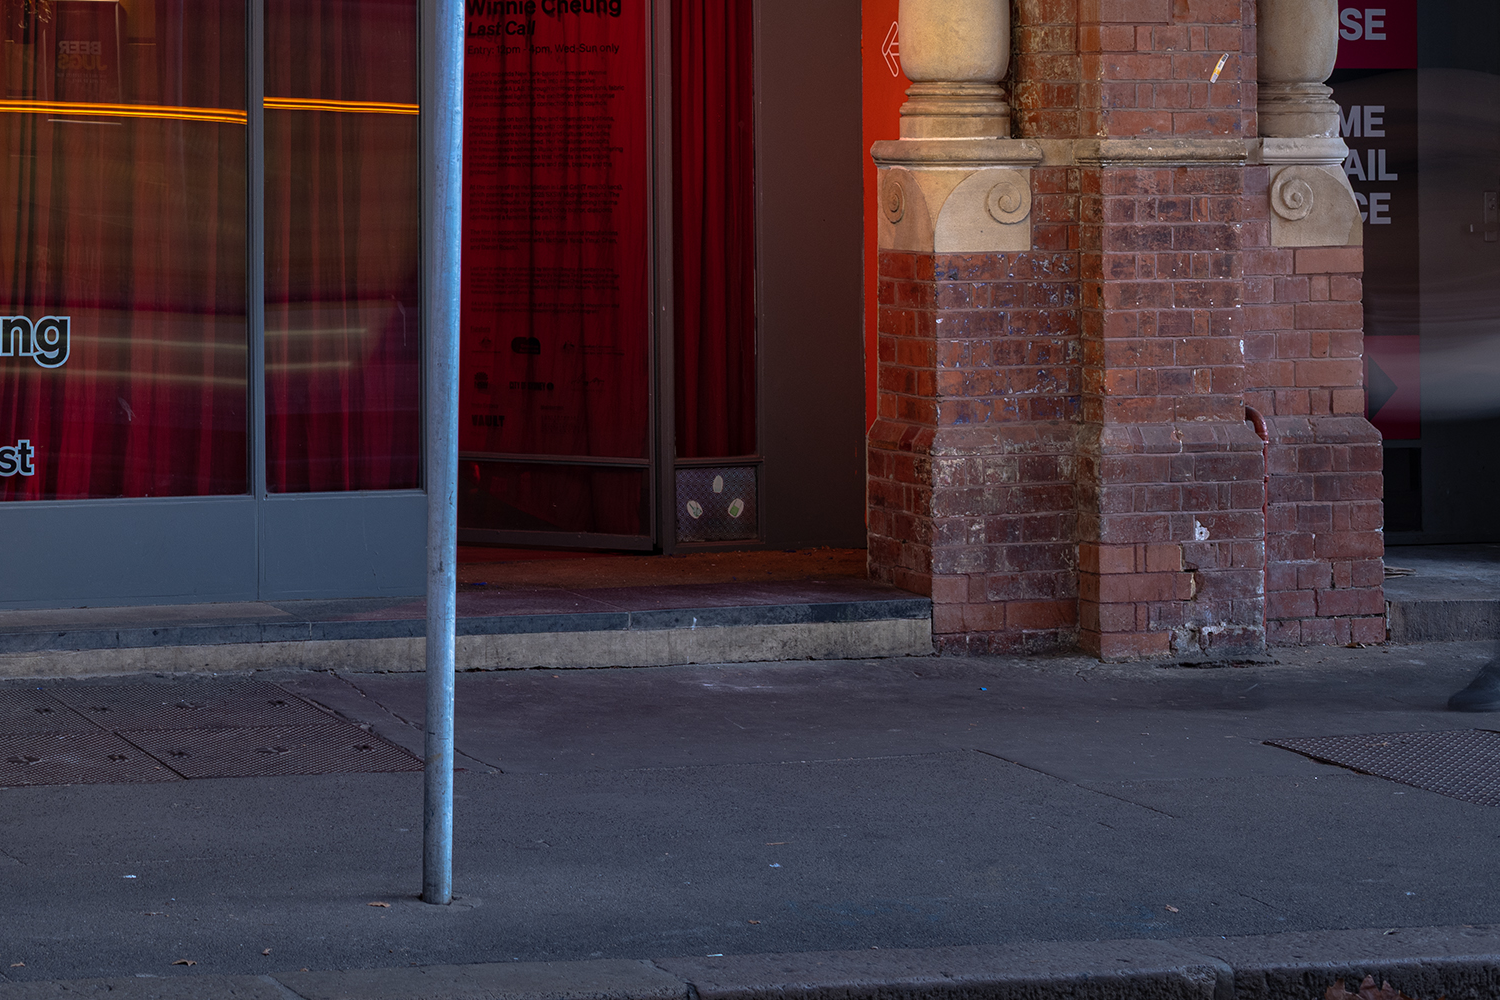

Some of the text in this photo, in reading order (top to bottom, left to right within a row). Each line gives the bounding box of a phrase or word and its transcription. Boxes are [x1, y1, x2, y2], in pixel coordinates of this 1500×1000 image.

[467, 21, 536, 37] Last Call
[1339, 8, 1387, 41] SE
[467, 45, 495, 57] Entry:
[555, 43, 598, 54] Wed-Sun
[599, 43, 620, 55] only
